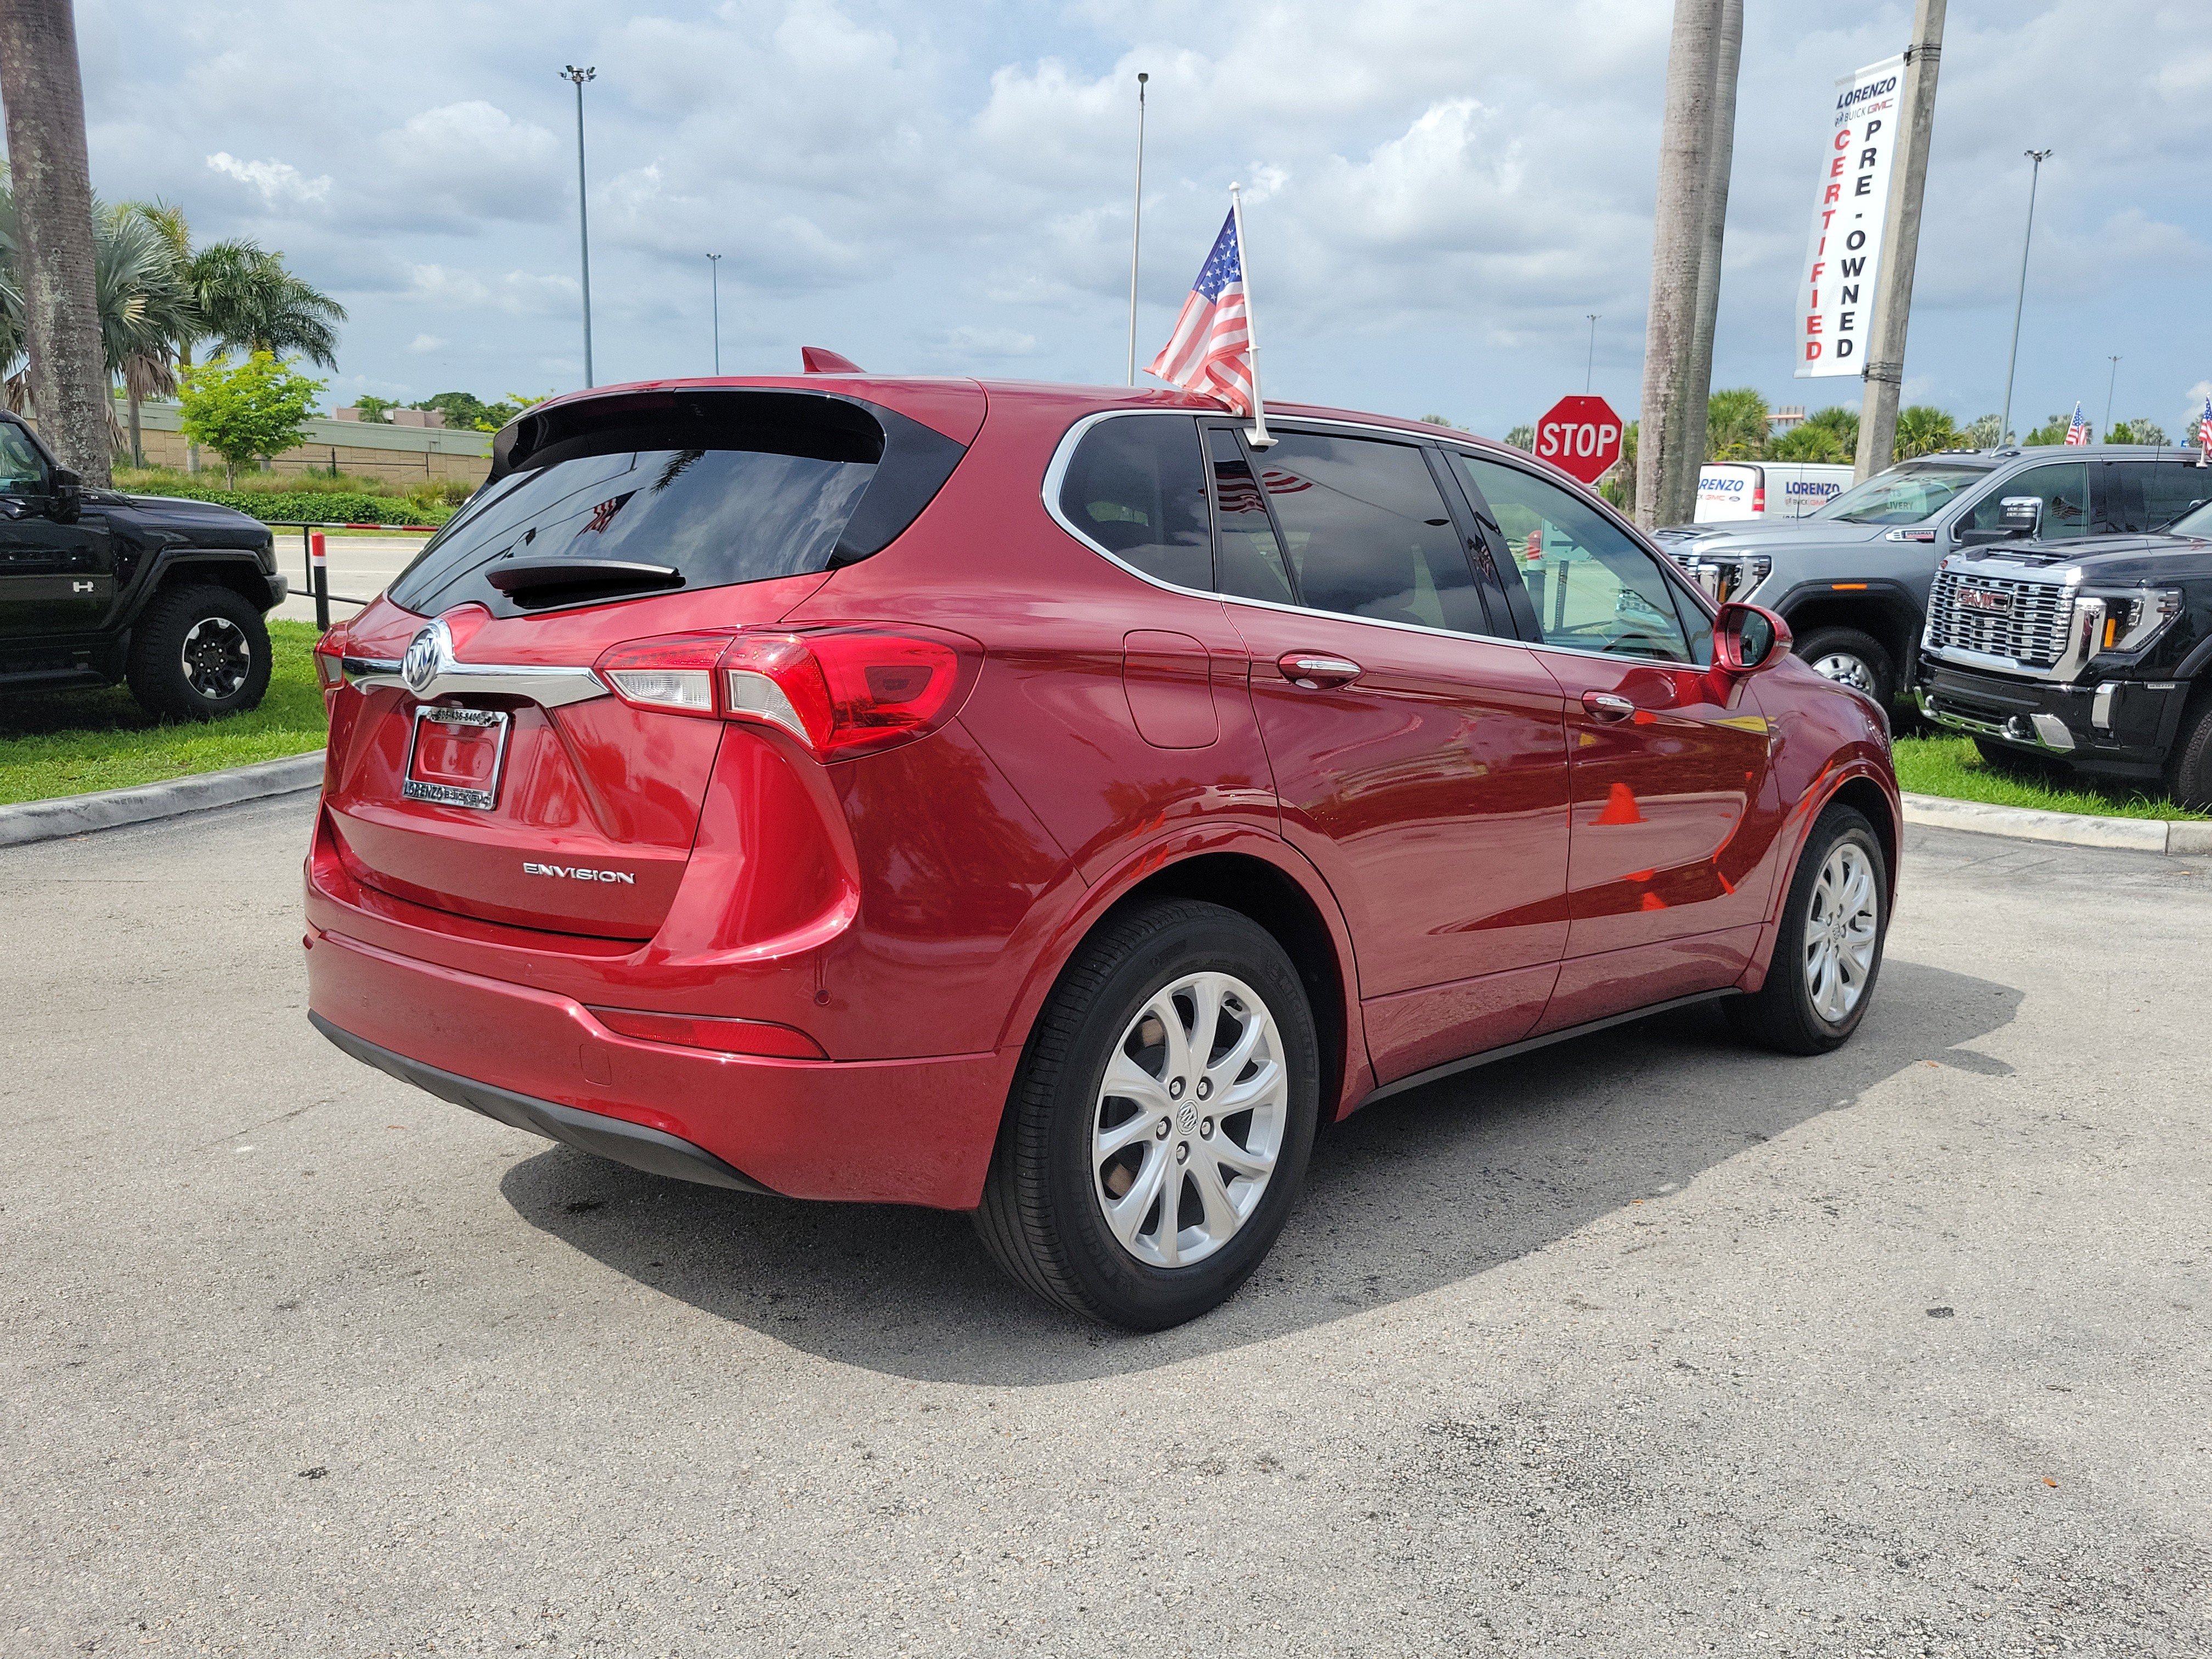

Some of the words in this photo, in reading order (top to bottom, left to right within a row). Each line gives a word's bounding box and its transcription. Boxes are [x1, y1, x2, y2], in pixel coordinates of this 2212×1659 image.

[1836, 76, 1897, 110] LORENZO
[1844, 106, 1866, 122] BUICK
[1867, 98, 1894, 114] GMC
[1805, 129, 1850, 361] CERTIFIED
[1836, 120, 1881, 358] PRE-OWNED
[1539, 422, 1617, 457] STOP
[1699, 478, 1743, 492] RENZO
[1785, 482, 1840, 495] LORENZO
[1886, 501, 1913, 510] LIVERY
[1956, 588, 2009, 612] GMC
[404, 782, 445, 801] LORENZO
[523, 862, 637, 884] ENVISION
